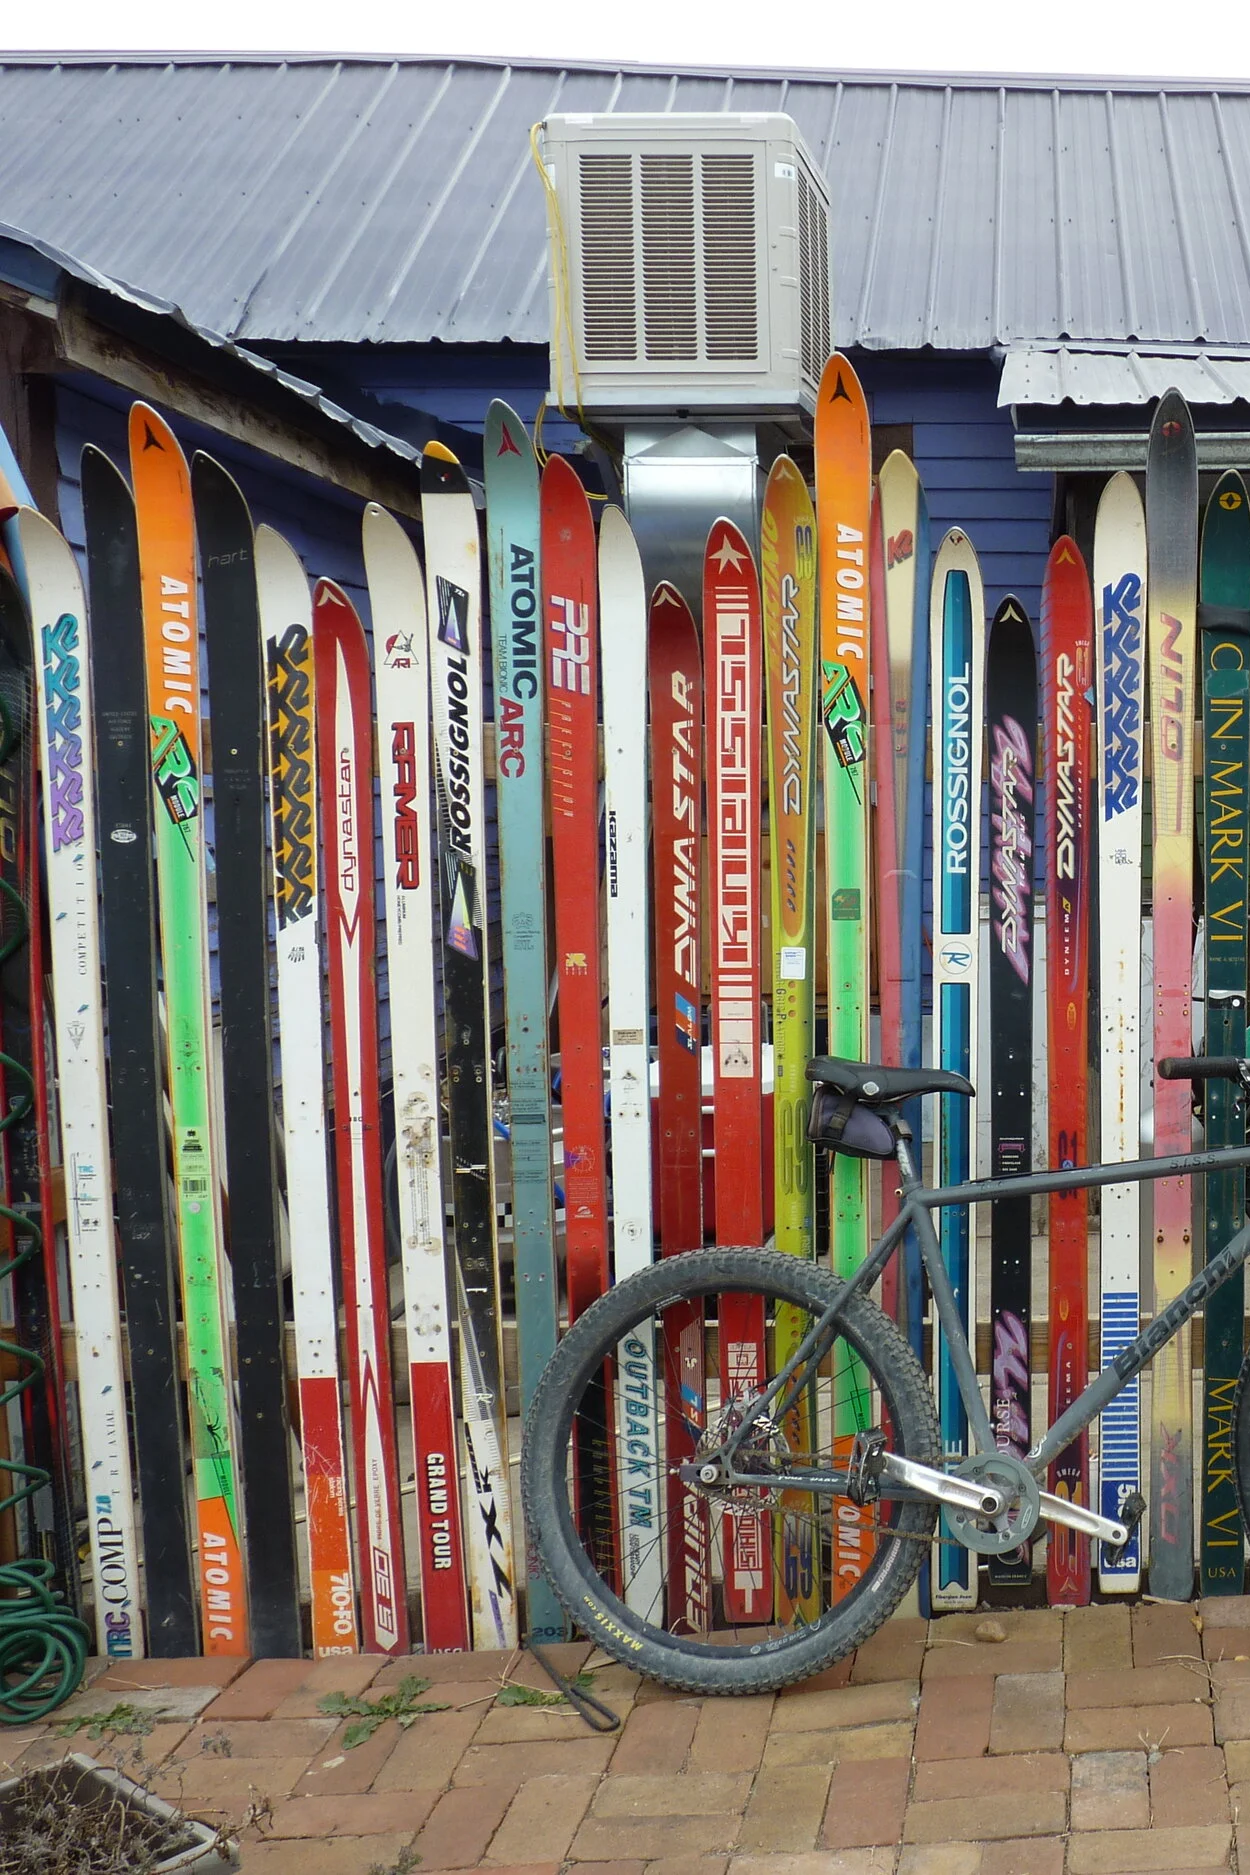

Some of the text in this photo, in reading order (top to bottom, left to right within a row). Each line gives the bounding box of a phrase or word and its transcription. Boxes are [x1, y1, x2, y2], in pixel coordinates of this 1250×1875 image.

[208, 547, 249, 569] hart
[836, 523, 864, 660] ATOMIC
[887, 529, 913, 570] K2
[160, 575, 193, 715] ATOMIC
[498, 634, 508, 694] TEAM BIONIC
[510, 543, 538, 700] ATOMIC
[551, 595, 592, 696] PRE
[447, 655, 472, 855] ROSSIGNOL
[500, 696, 526, 780] ARC
[781, 573, 802, 816] DYNASTAR
[822, 660, 867, 761] ARC
[151, 714, 199, 818] ARC
[341, 753, 354, 891] dynastar
[391, 721, 420, 890] RAMER
[946, 662, 969, 873] ROSSIGNOL
[1056, 653, 1075, 880] DYNASTAR
[1210, 760, 1244, 884] MARK
[672, 670, 698, 987] DYNASTAR
[999, 747, 1024, 954] DYNASTAR
[1210, 900, 1244, 941] VI
[1112, 1250, 1238, 1381] Bianchi
[105, 1410, 121, 1497] TRIAXIAL
[624, 1338, 650, 1479] OUTBACK
[996, 1398, 1010, 1456] OURSE
[1206, 1376, 1239, 1547] MARK VI
[97, 1517, 128, 1605] COMP
[427, 1452, 452, 1572] GRAND TOUR
[628, 1488, 653, 1529] TM
[683, 1491, 709, 1633] EQUIP
[203, 1532, 235, 1642] ATOMIC
[1208, 1567, 1237, 1578] USA
